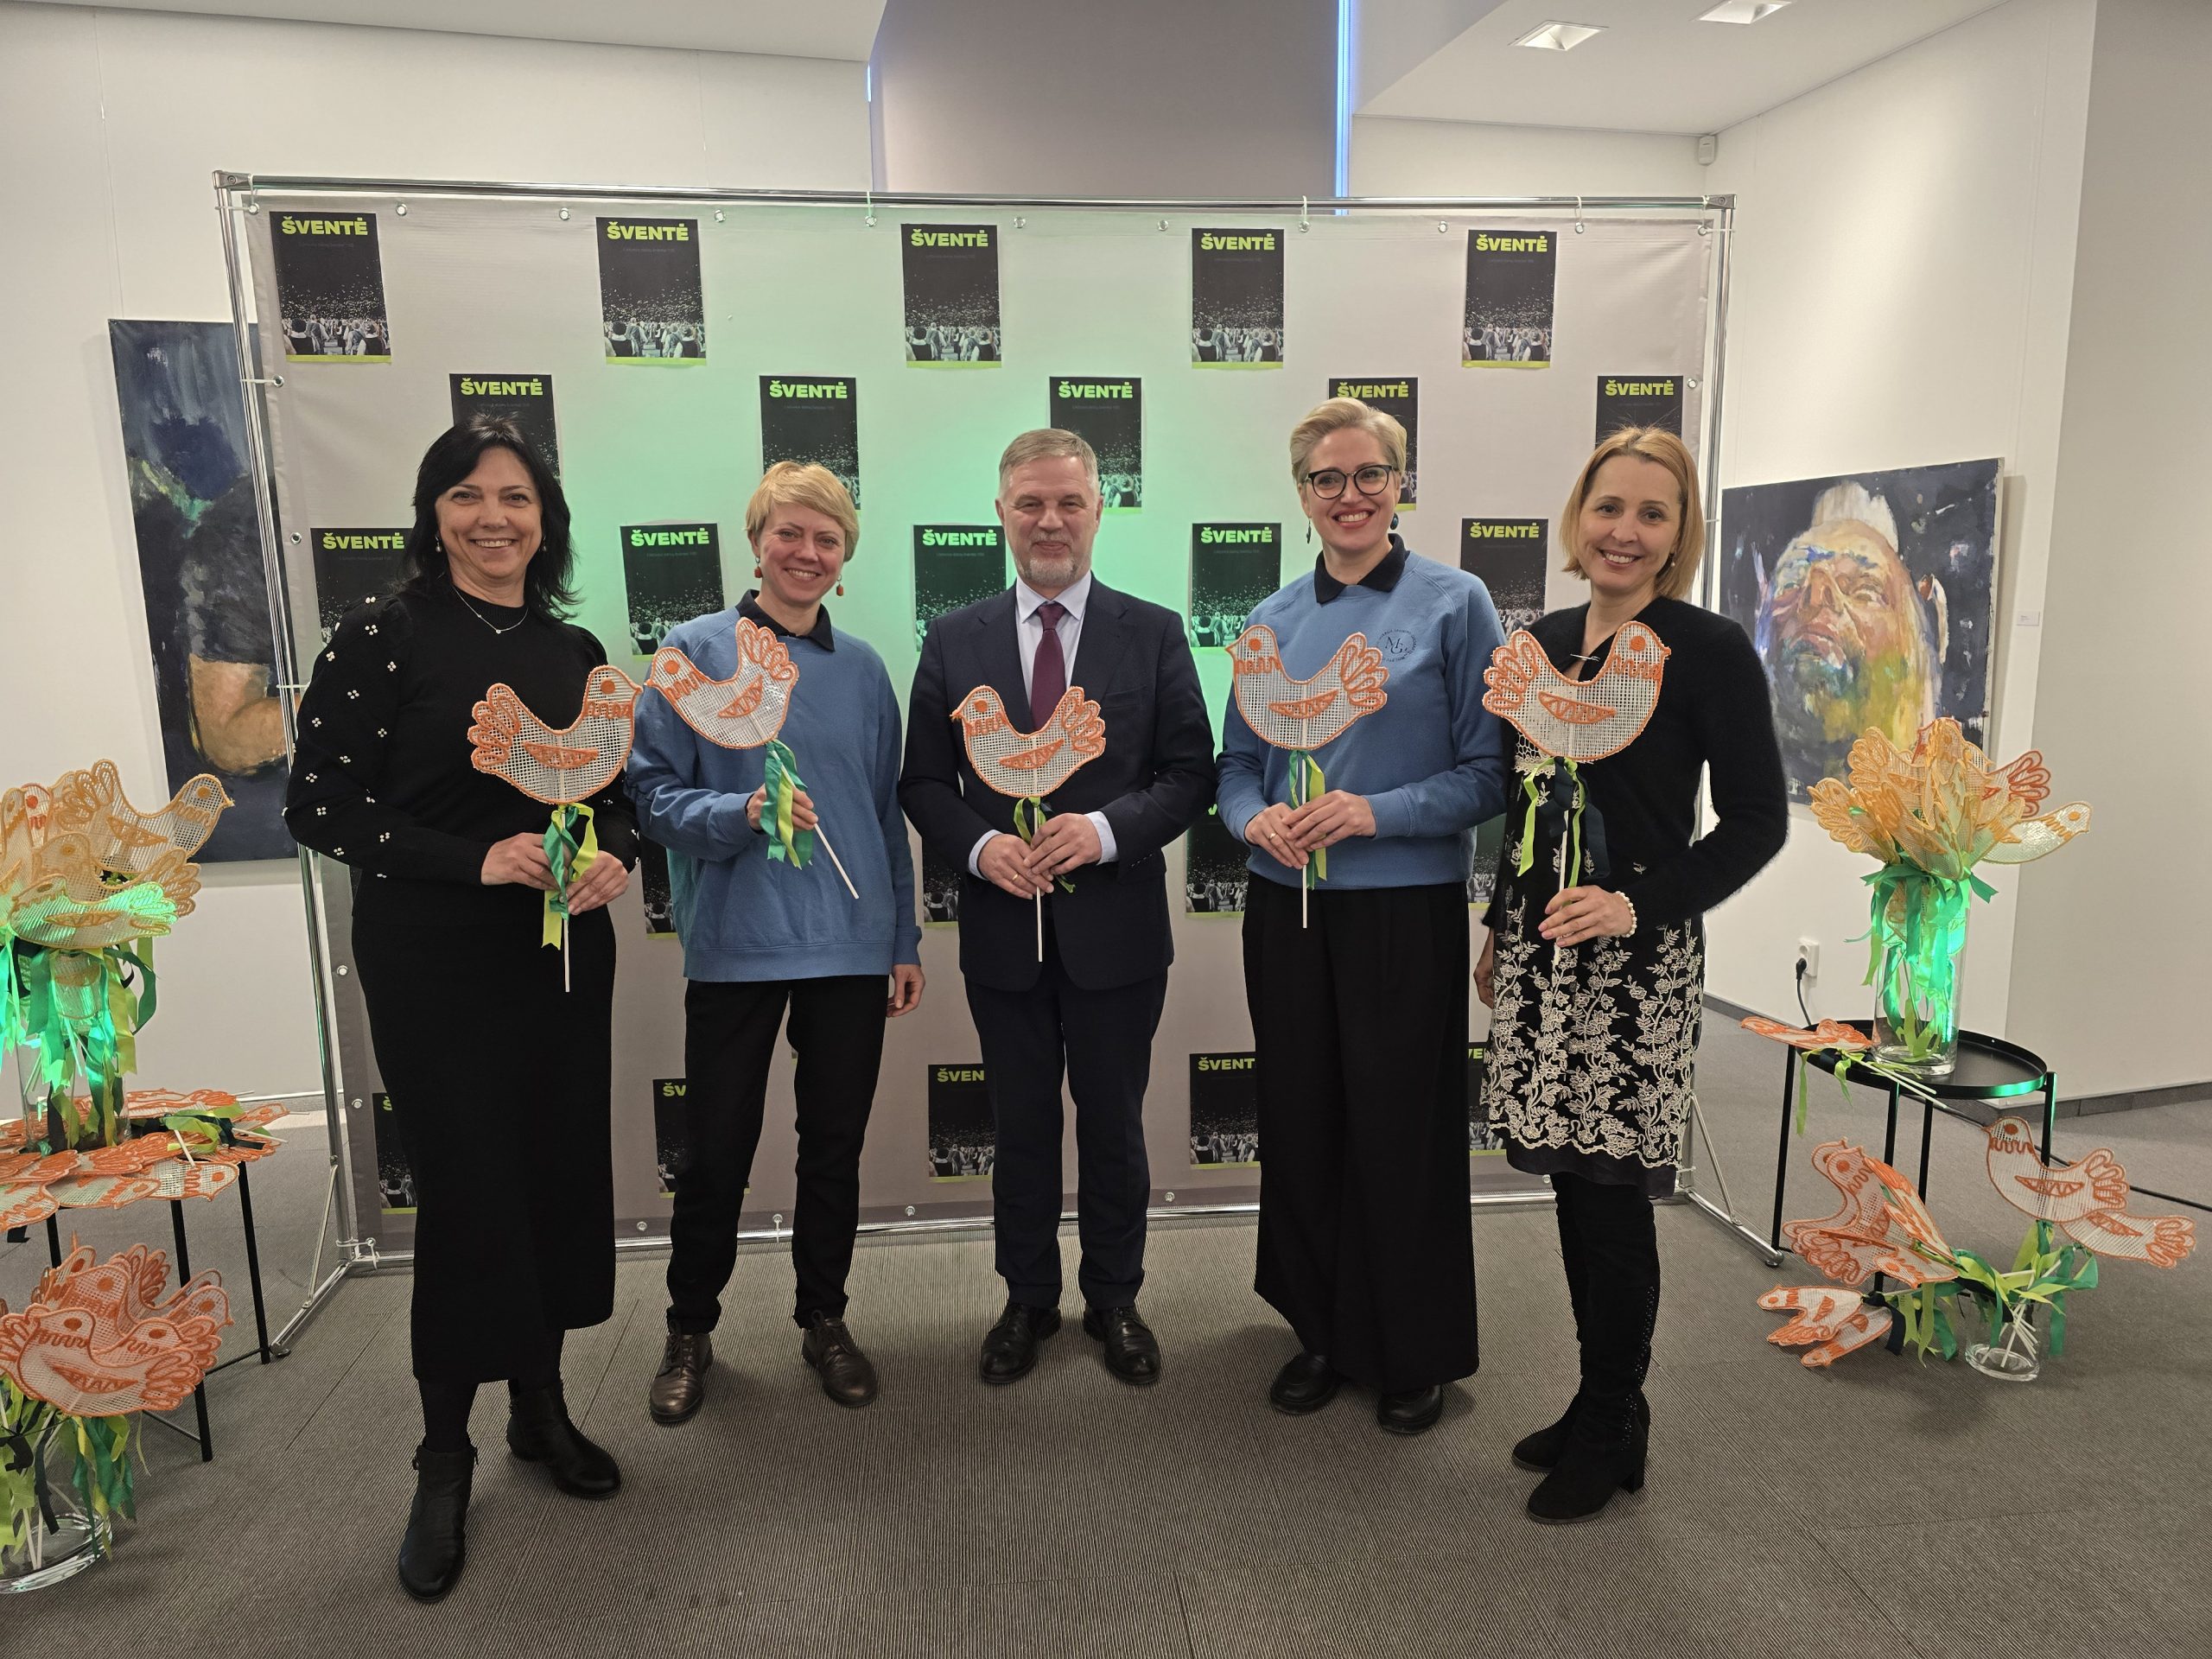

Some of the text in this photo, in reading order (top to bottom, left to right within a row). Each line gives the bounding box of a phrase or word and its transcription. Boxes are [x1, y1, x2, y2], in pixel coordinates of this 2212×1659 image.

[282, 216, 368, 235] ŠVENTĖ
[607, 221, 689, 242] ŠVENTĖ
[911, 229, 988, 247] ŠVENTĖ
[1202, 233, 1275, 251] ŠVENTĖ
[1476, 233, 1548, 252] ŠVENTĖ
[461, 378, 543, 396] ŠVENTĖ
[769, 380, 848, 398] ŠVENTĖ
[1058, 381, 1133, 398] ŠVENTĖ
[1337, 381, 1409, 398] ŠVENTĖ
[1605, 379, 1674, 396] ŠVENTĖ
[631, 527, 709, 547] ŠVENTĖ
[922, 529, 997, 546] ŠVENTĖ
[1200, 526, 1273, 543] ŠVENTĖ
[1470, 522, 1540, 538] ŠVENTĖ
[322, 532, 404, 550] ŠVENTĖ
[1198, 1057, 1255, 1071] ŠVENT
[937, 1068, 985, 1083] ŠVEN
